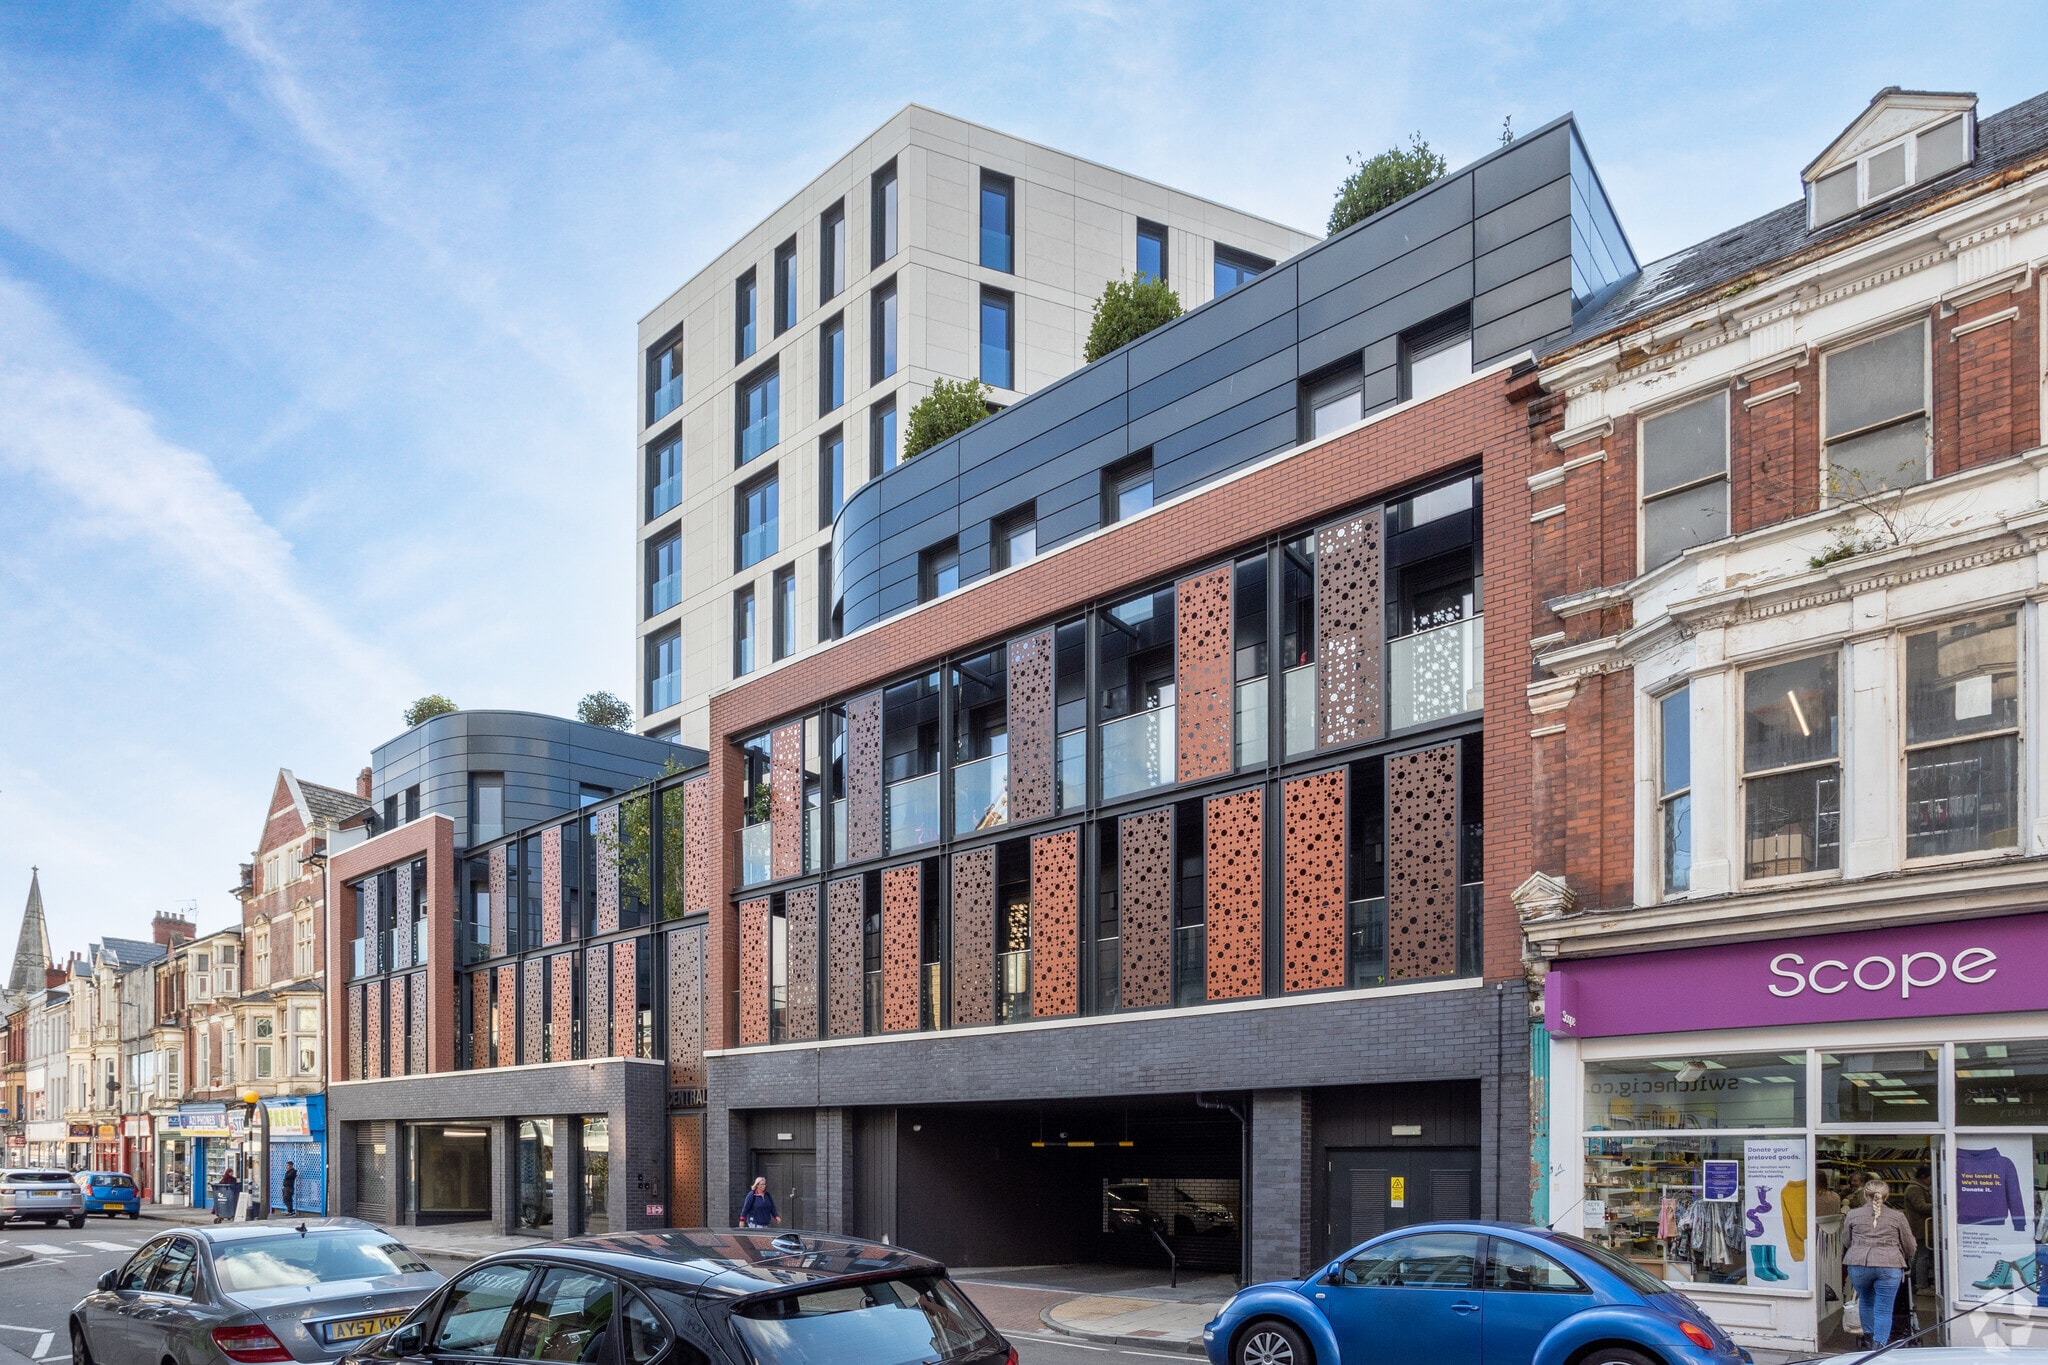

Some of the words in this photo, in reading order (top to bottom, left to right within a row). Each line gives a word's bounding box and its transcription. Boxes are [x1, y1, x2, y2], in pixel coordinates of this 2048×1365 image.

[1768, 947, 1997, 998] Scope
[1562, 1010, 1576, 1027] Scope
[336, 1320, 375, 1338] AY57
